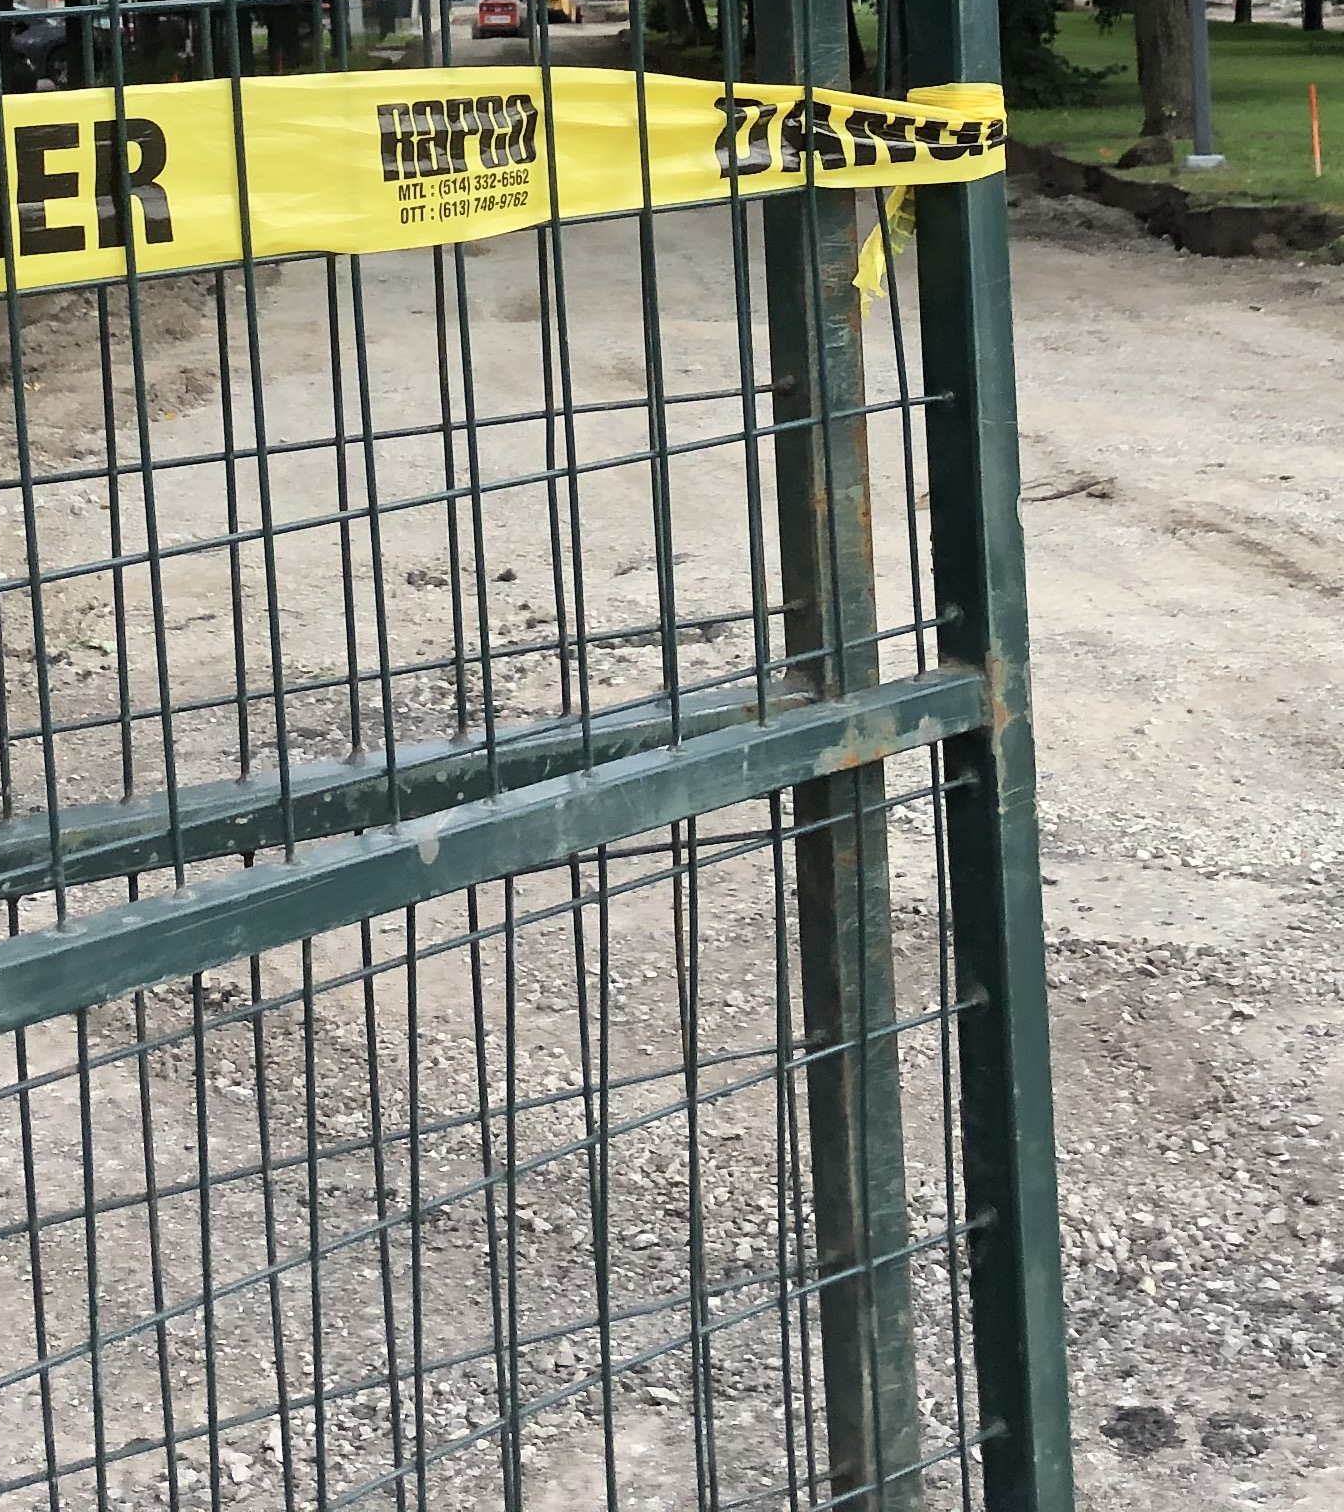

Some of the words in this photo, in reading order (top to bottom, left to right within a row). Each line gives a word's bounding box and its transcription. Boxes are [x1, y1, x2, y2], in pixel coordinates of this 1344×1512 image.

[398, 182, 427, 201] MTL
[438, 176, 471, 199] (514)
[474, 169, 530, 191] 332-6562
[400, 205, 426, 224] OTT
[439, 199, 470, 221] (613)
[474, 191, 529, 213] 748-9762
